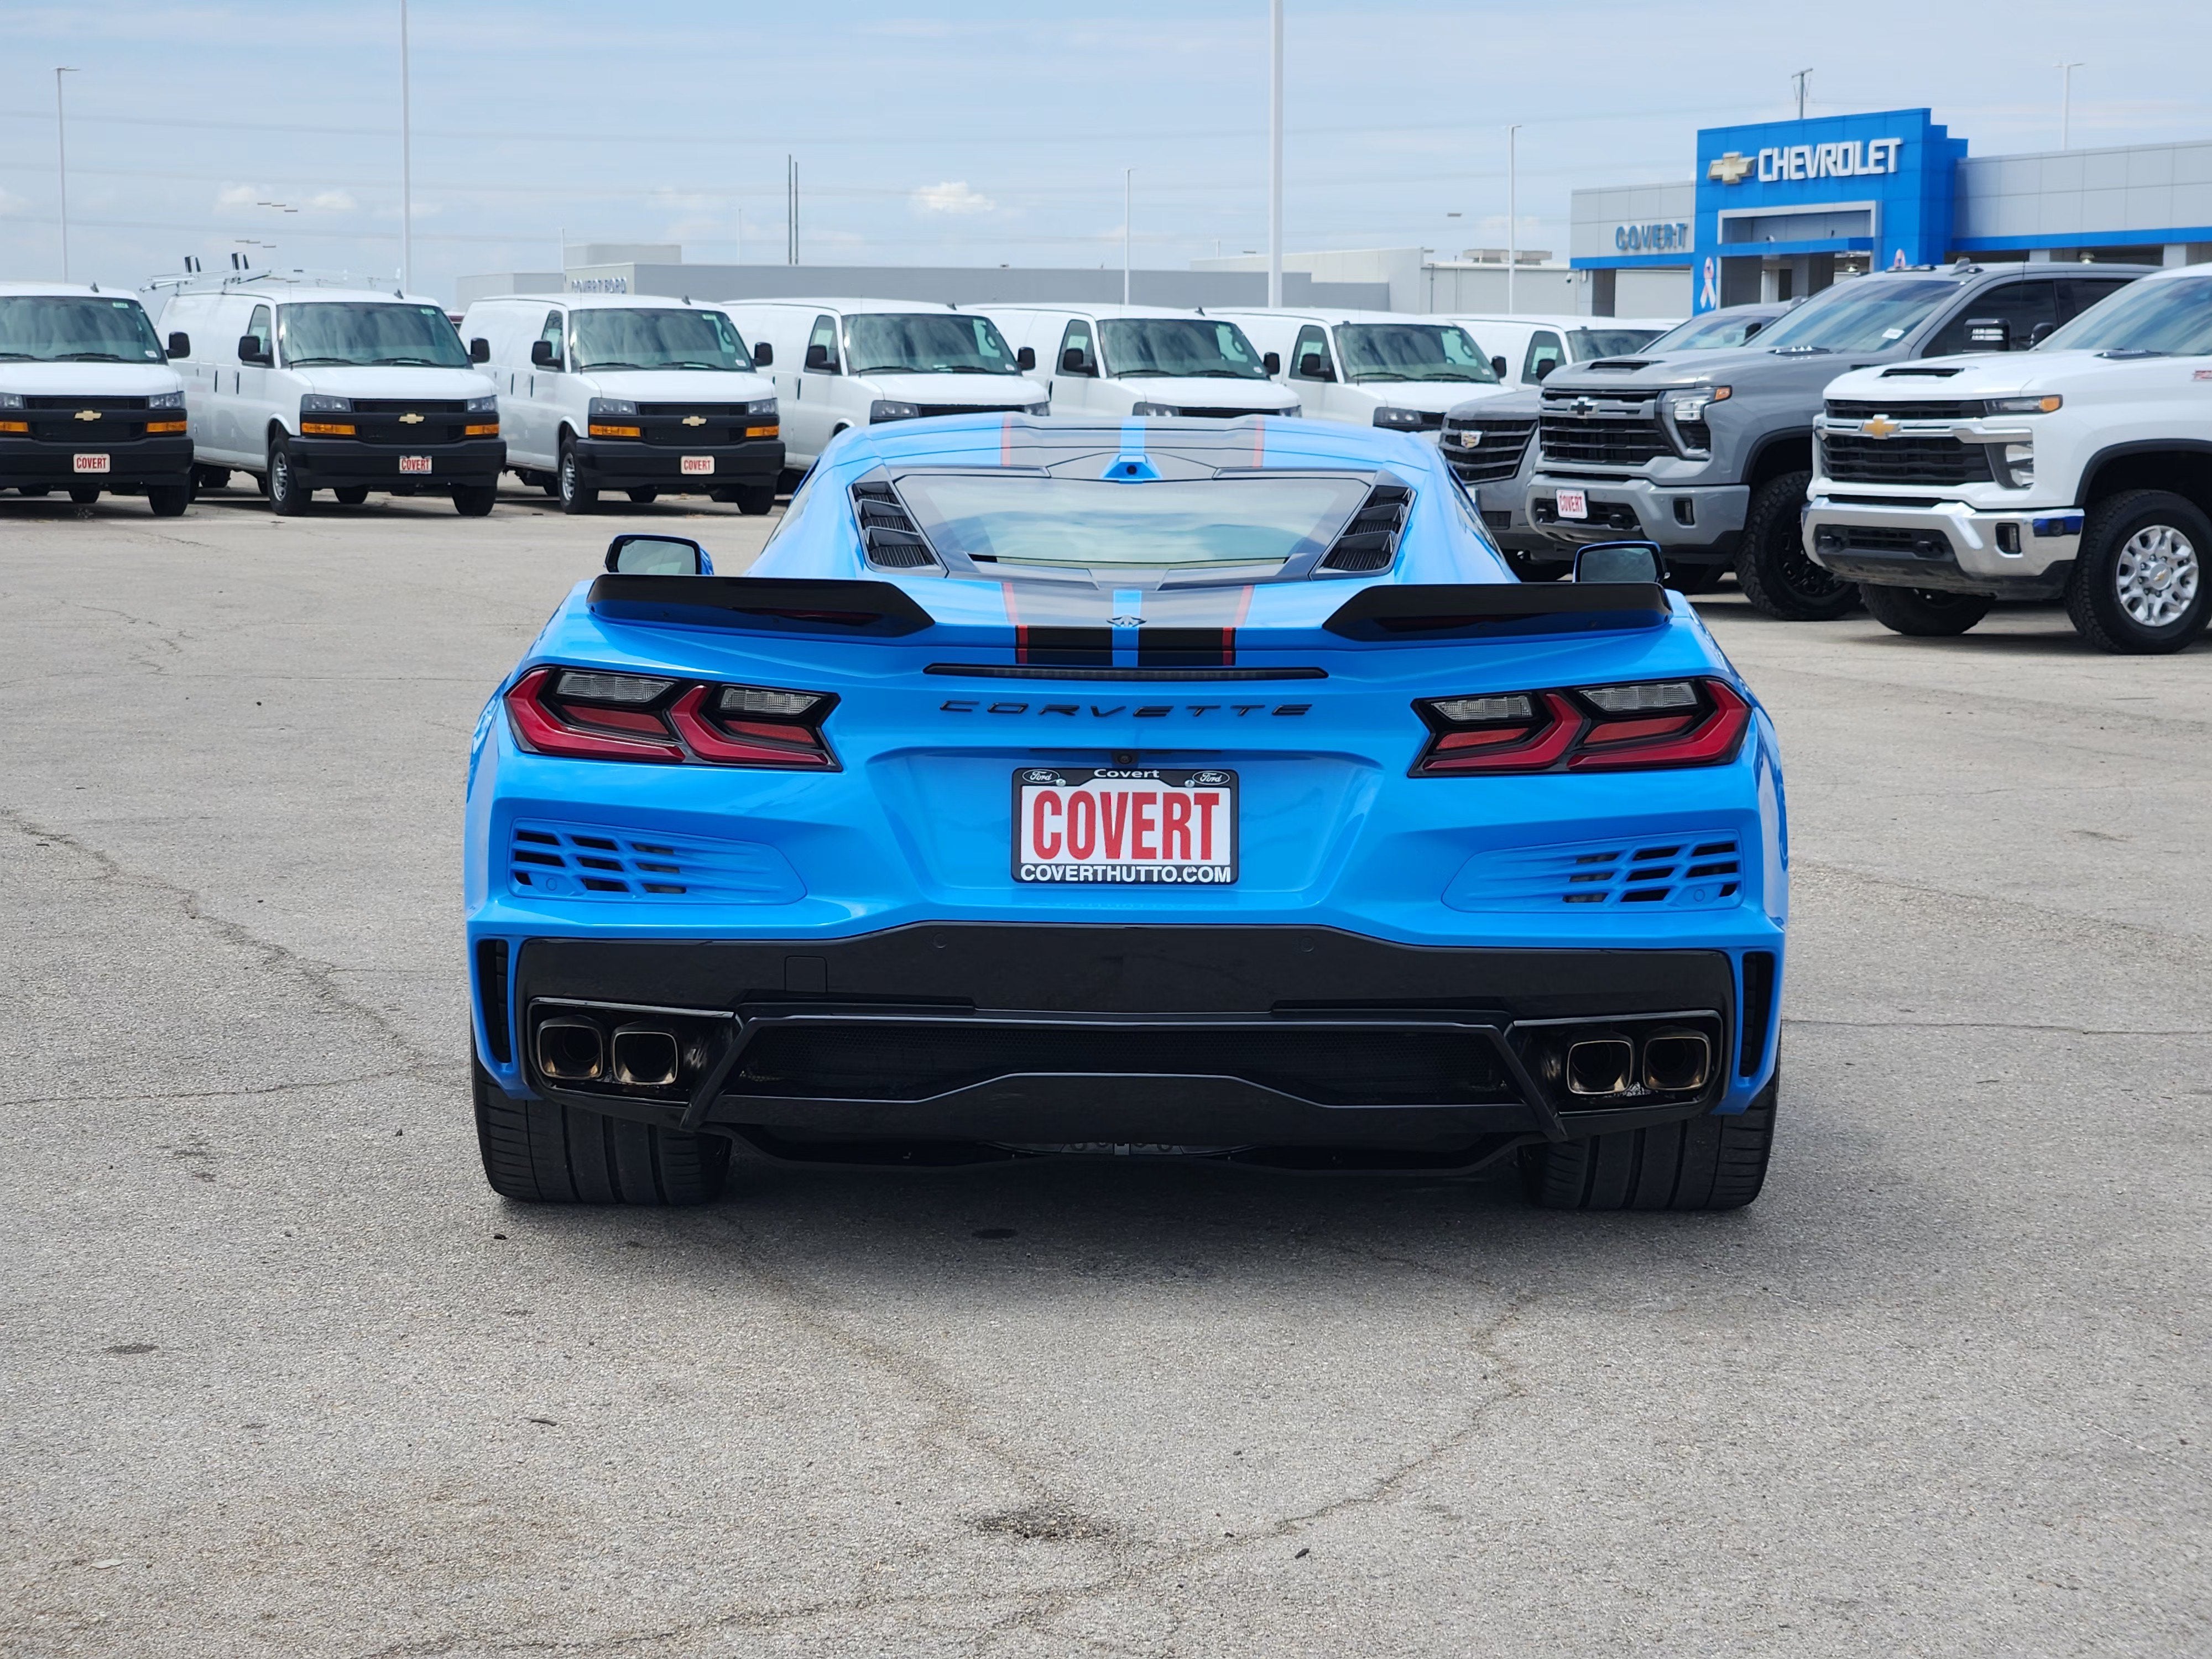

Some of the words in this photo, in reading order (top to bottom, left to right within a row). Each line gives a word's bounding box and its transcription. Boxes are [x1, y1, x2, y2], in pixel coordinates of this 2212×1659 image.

[1758, 137, 1902, 182] CHEVROLET
[1615, 223, 1688, 251] COVERT
[76, 457, 107, 469] COVERT
[401, 458, 430, 470] COVERT
[684, 460, 711, 471] COVERT
[1559, 495, 1583, 513] COVERT
[939, 700, 1313, 718] CORVETTE
[1030, 771, 1053, 781] Ford
[1093, 769, 1160, 779] Covert
[1199, 772, 1223, 782] Ford
[1033, 790, 1219, 860] COVERT
[1020, 864, 1231, 883] COVERTHUTTO.COM
